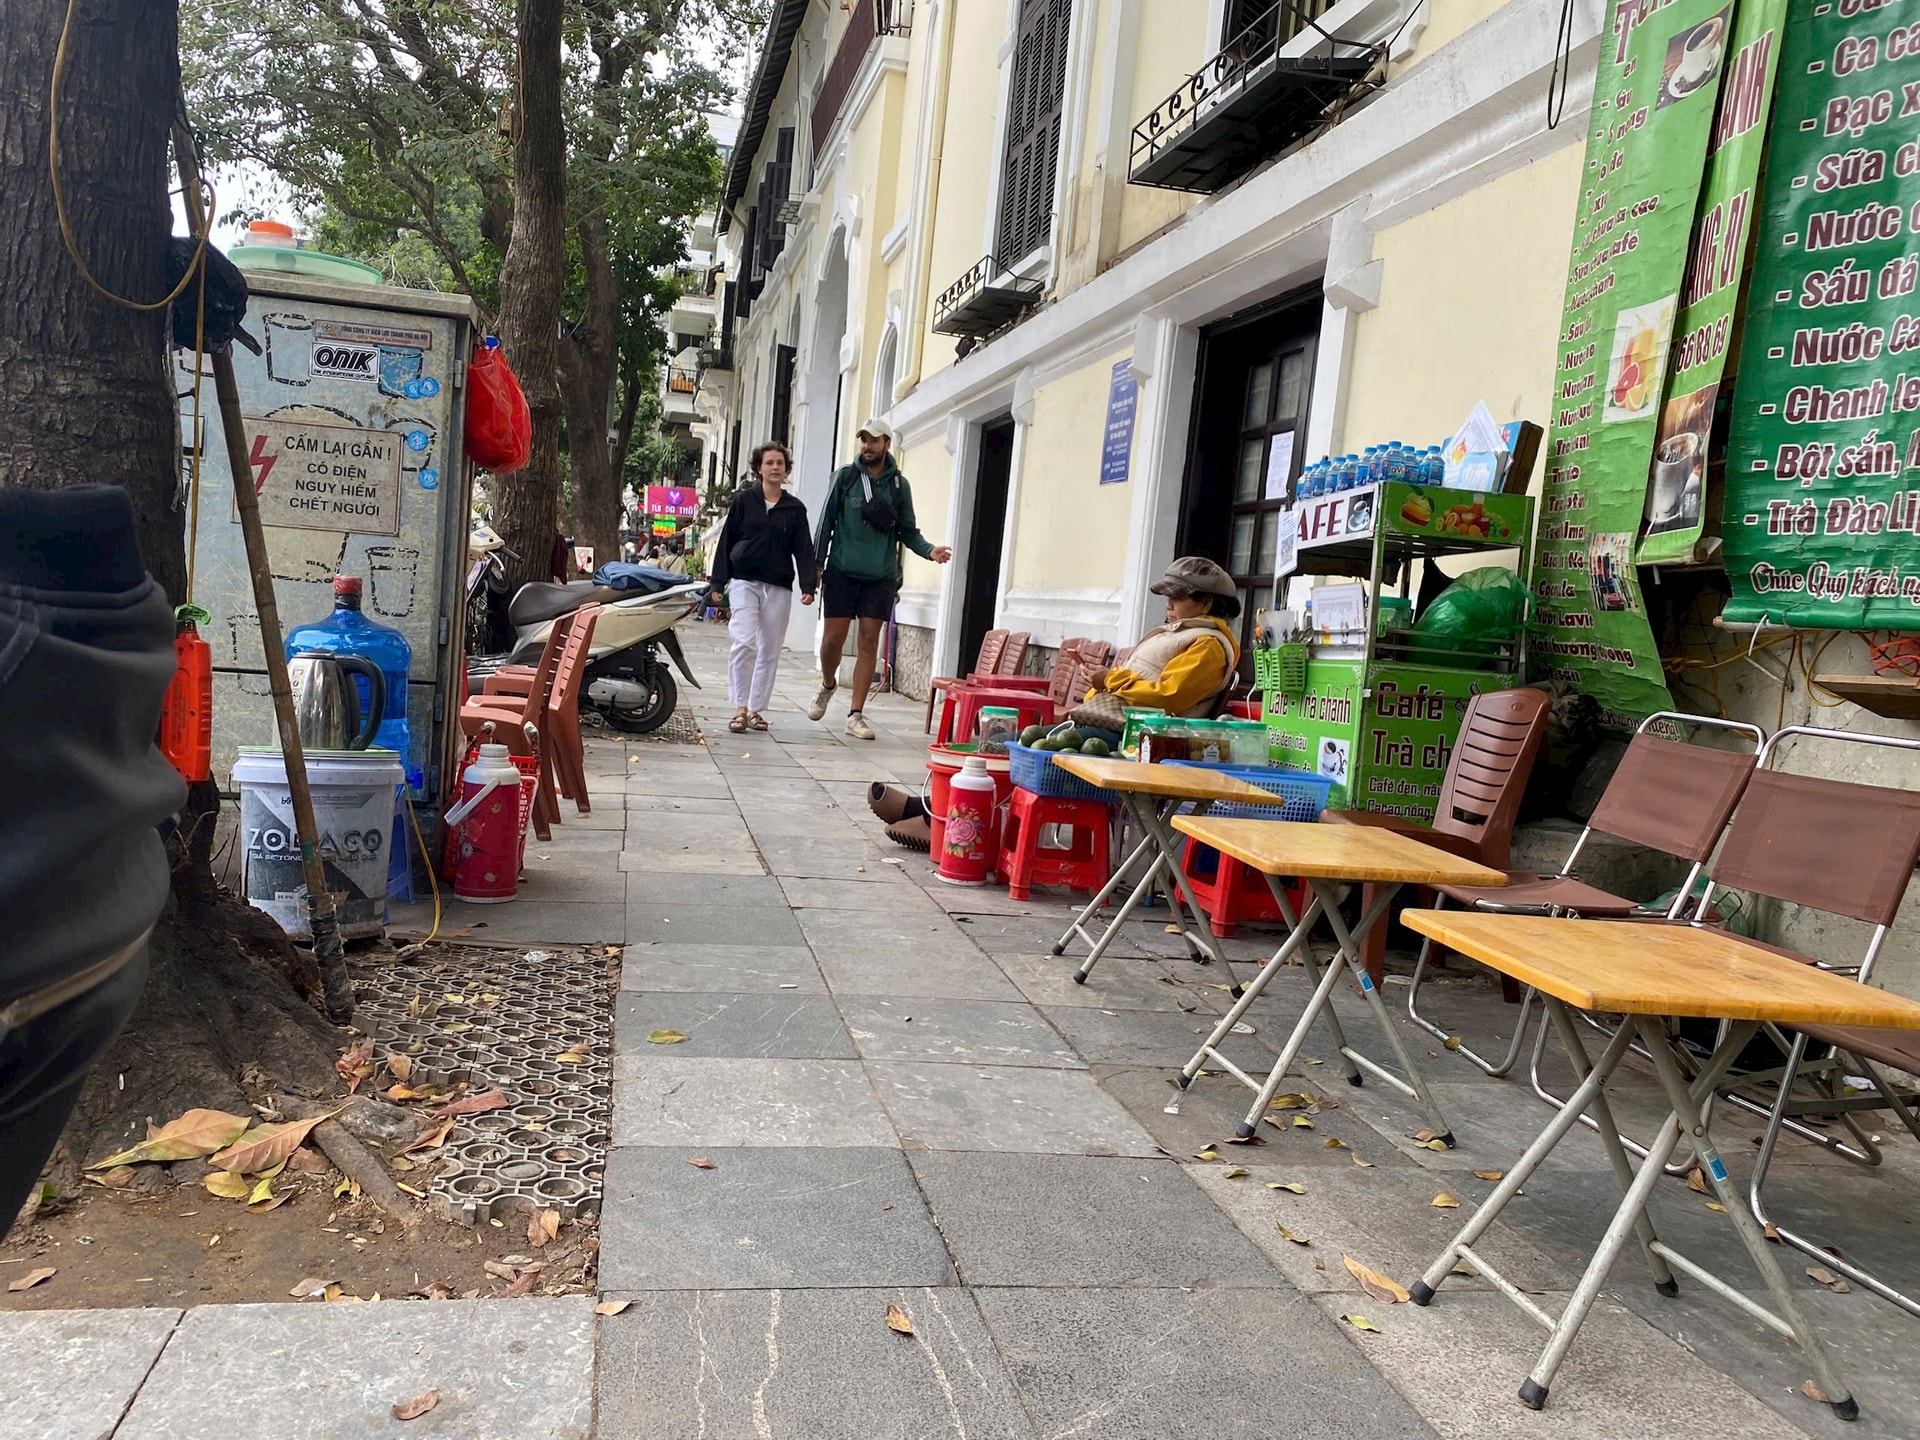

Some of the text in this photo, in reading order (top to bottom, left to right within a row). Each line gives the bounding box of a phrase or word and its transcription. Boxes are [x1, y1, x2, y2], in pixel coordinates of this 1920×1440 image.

[1833, 36, 1879, 77] Ca
[1824, 90, 1893, 137] Bạc
[1813, 148, 1886, 193] Sữa
[1805, 202, 1902, 251] Nước
[1799, 252, 1918, 309] Sấu đá
[1791, 322, 1883, 367] Nước
[1783, 378, 1888, 424] Chanh
[285, 432, 319, 453] CẤM
[323, 440, 346, 459] LẠI
[350, 436, 383, 460] GẦN
[1775, 443, 1834, 487] Bột
[1835, 429, 1901, 479] sắn,
[295, 479, 377, 499] NGUY HIỂM
[307, 461, 367, 481] CÓ ĐIỆN
[289, 495, 380, 517] CHẾT NGƯỜI
[1767, 499, 1817, 535] Trà
[1824, 496, 1889, 535] Đào
[1751, 562, 1804, 593] Chúc
[1807, 562, 1847, 603] Quý
[1318, 684, 1352, 725] chanh
[1377, 681, 1445, 722] Café
[1371, 728, 1414, 768] Trà
[1369, 776, 1395, 795] Café
[1397, 778, 1420, 797] đen,
[1366, 798, 1401, 817] Cacao
